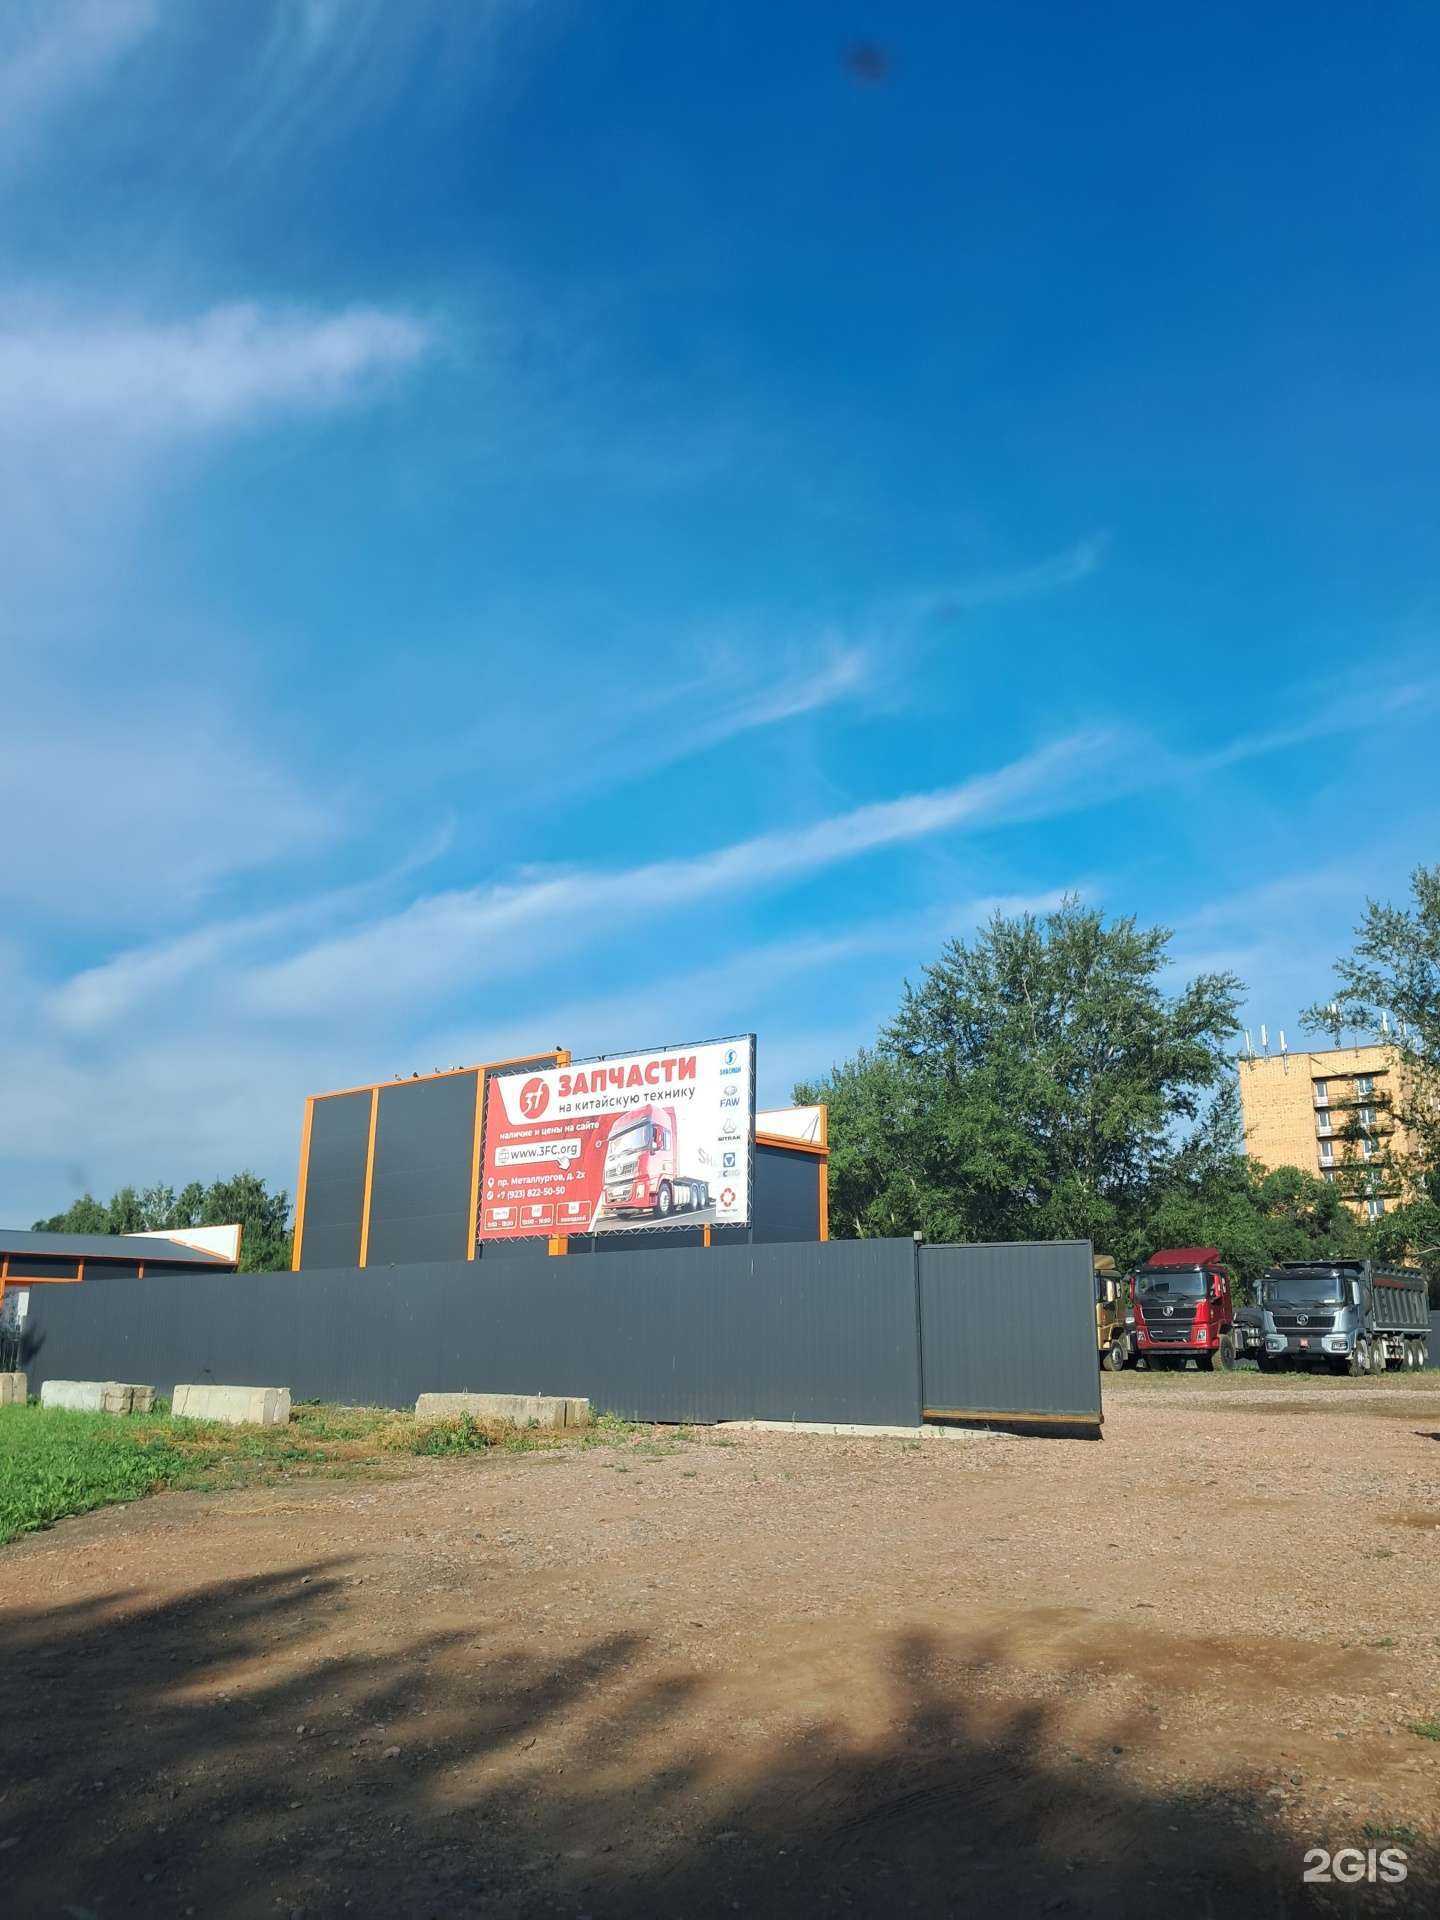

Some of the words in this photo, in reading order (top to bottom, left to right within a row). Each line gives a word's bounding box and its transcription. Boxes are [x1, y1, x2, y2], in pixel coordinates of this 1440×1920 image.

[558, 1056, 696, 1097] ЗАПЧАСТИ
[560, 1104, 572, 1112] на
[575, 1093, 640, 1110] китайскую
[644, 1086, 696, 1103] технику
[720, 1097, 740, 1107] FAW
[500, 1129, 533, 1139] наличие
[541, 1126, 563, 1136] цены
[576, 1121, 599, 1131] сайте
[510, 1143, 577, 1160] www.3FC.org
[511, 1173, 565, 1187] Металлургов,
